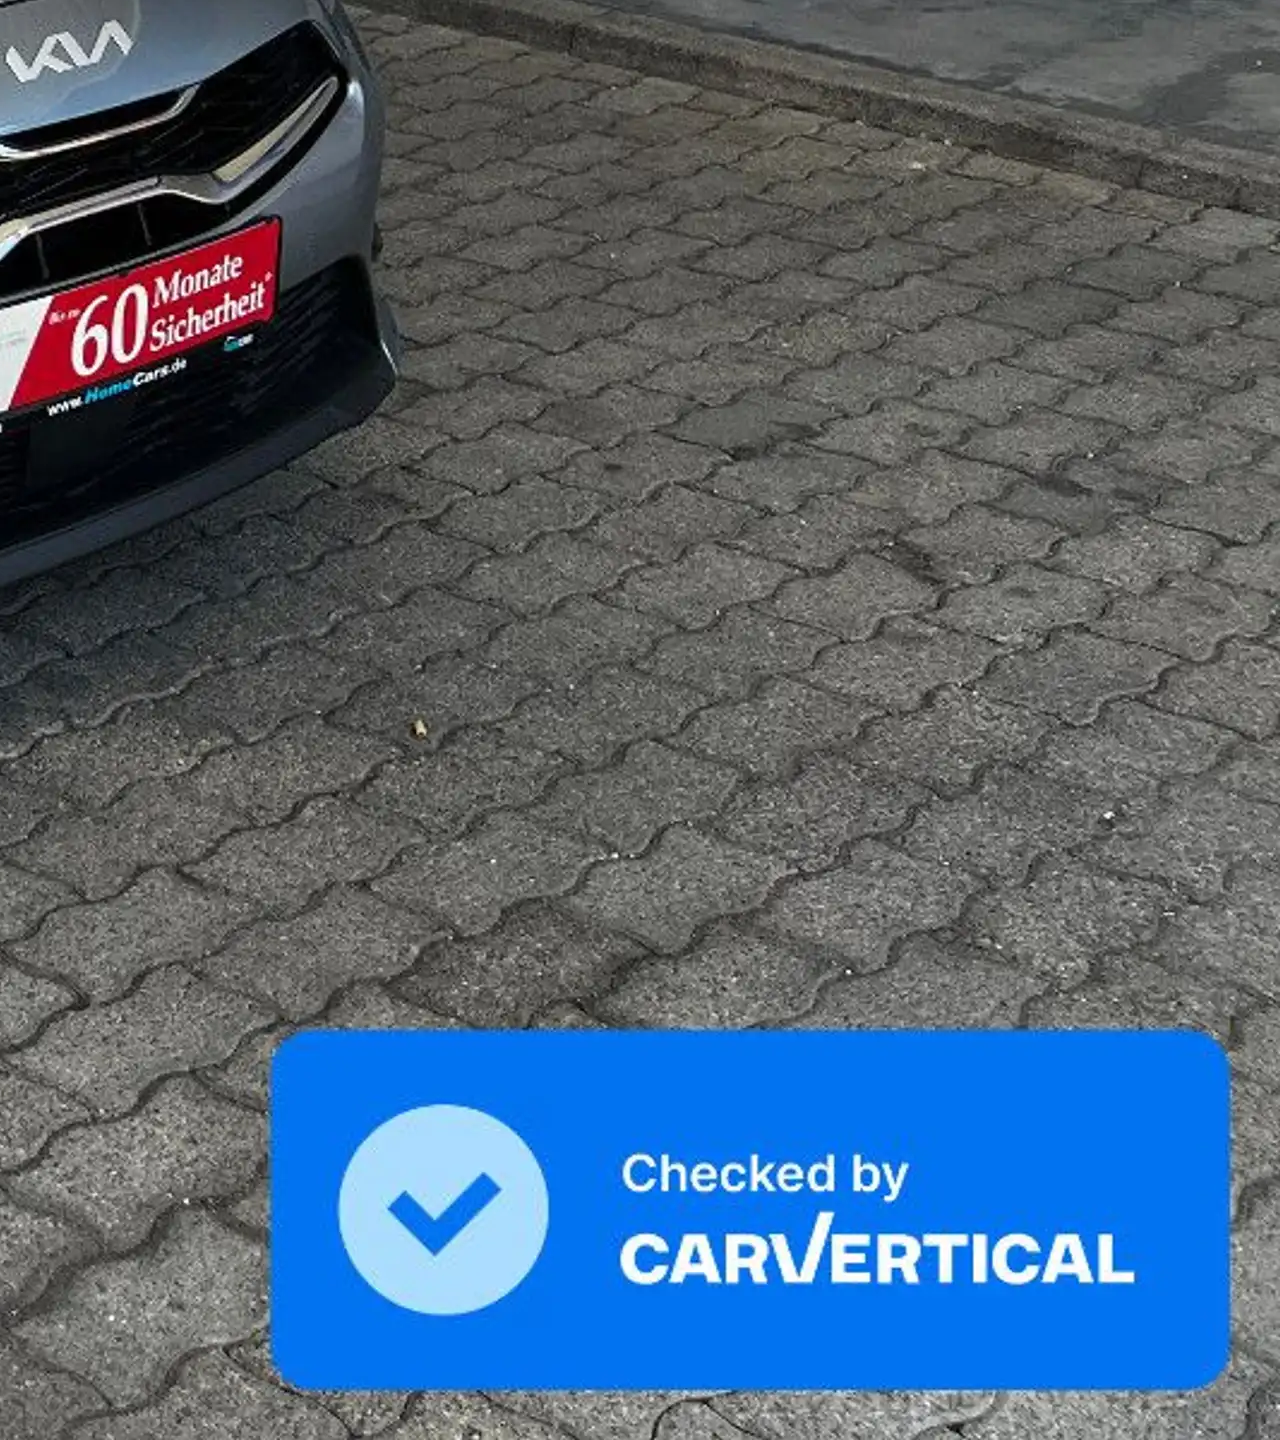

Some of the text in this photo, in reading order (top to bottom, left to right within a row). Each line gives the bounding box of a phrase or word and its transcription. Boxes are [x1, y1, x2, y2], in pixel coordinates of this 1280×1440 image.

[6, 19, 133, 83] KIA
[152, 254, 244, 309] Monate
[71, 282, 148, 377] 60
[149, 280, 266, 353] Sicherheit
[47, 358, 188, 416] www.HomeCars.de
